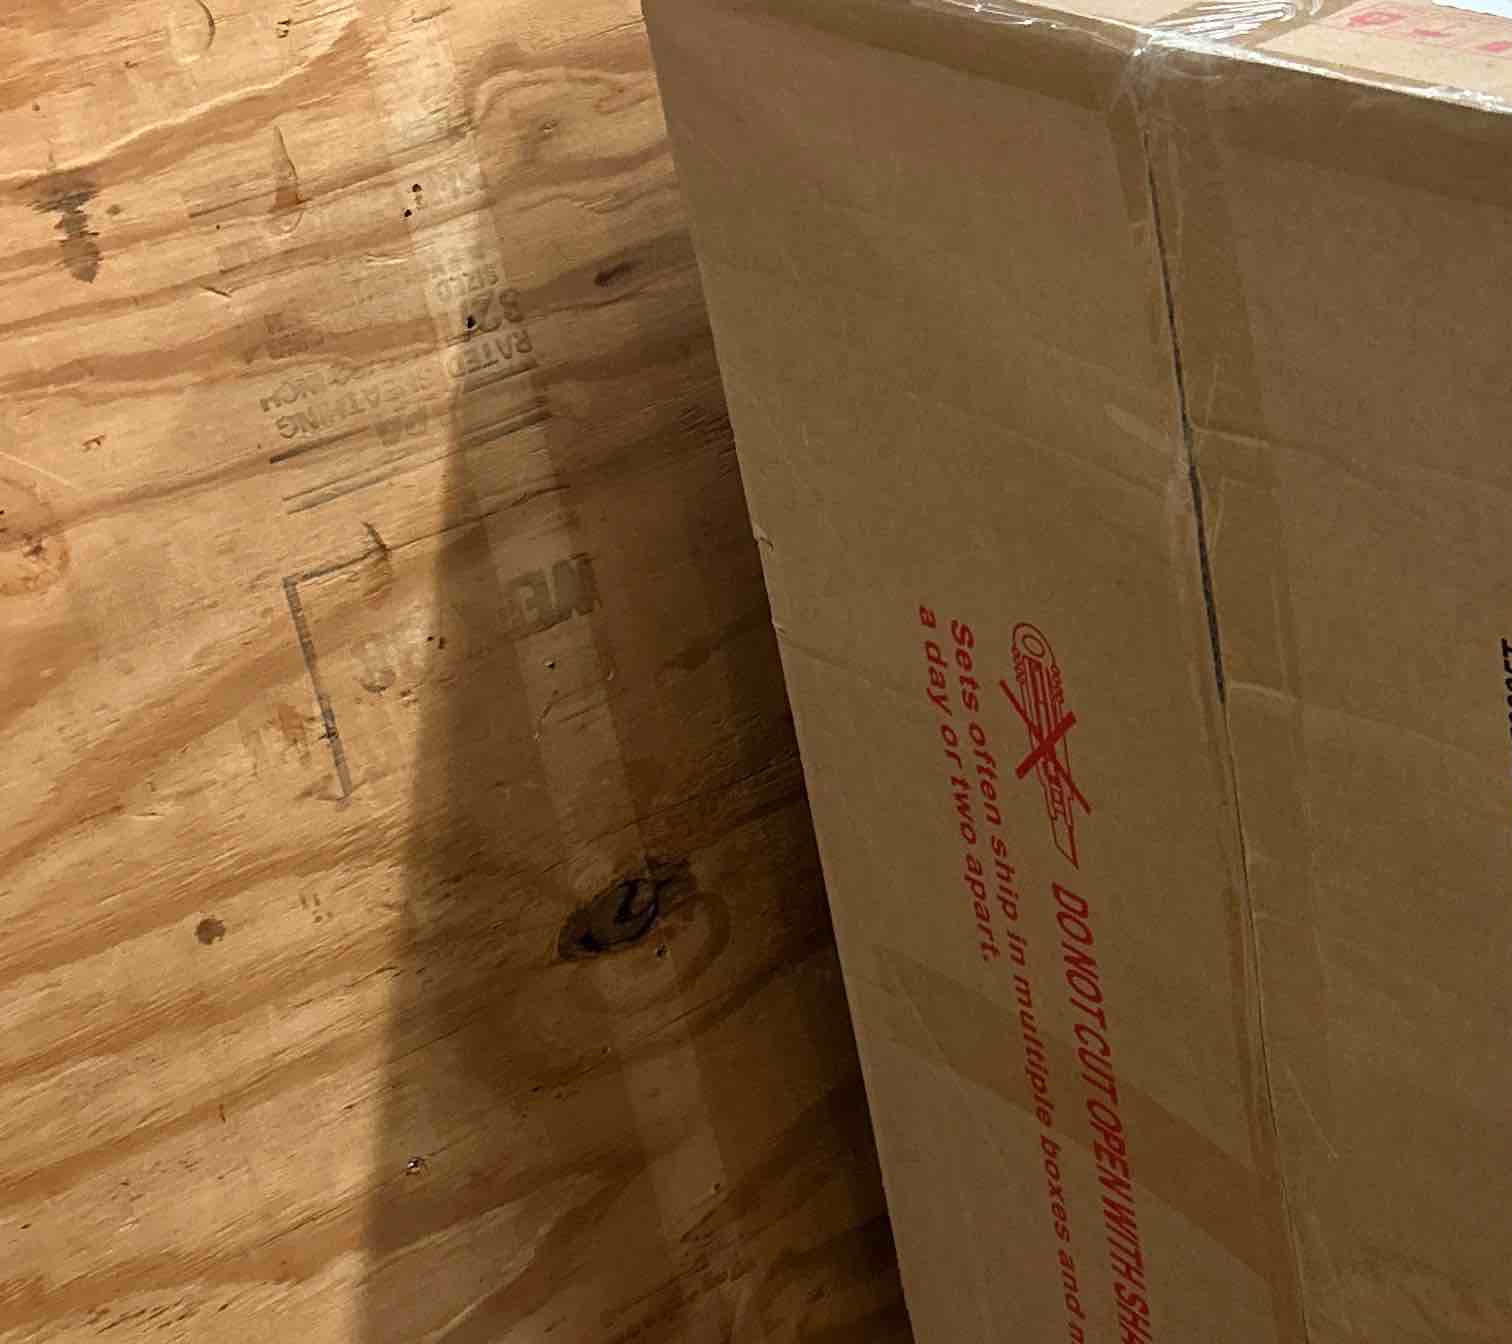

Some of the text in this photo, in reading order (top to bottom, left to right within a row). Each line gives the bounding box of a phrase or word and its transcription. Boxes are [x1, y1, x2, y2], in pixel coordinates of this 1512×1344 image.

[951, 620, 981, 712] Sets
[919, 604, 999, 960] a day or two apart.
[968, 722, 1002, 826] often
[990, 835, 1019, 921] ship
[1051, 882, 1094, 946] DO
[996, 929, 1028, 966] in
[1061, 940, 1107, 1031] NOT
[1013, 975, 1055, 1128] multiple
[1074, 1024, 1118, 1107] CUT
[1040, 1135, 1070, 1243] boxes
[1086, 1098, 1133, 1202] OPEN
[1058, 1249, 1086, 1320] and
[1103, 1196, 1146, 1291] WITH
